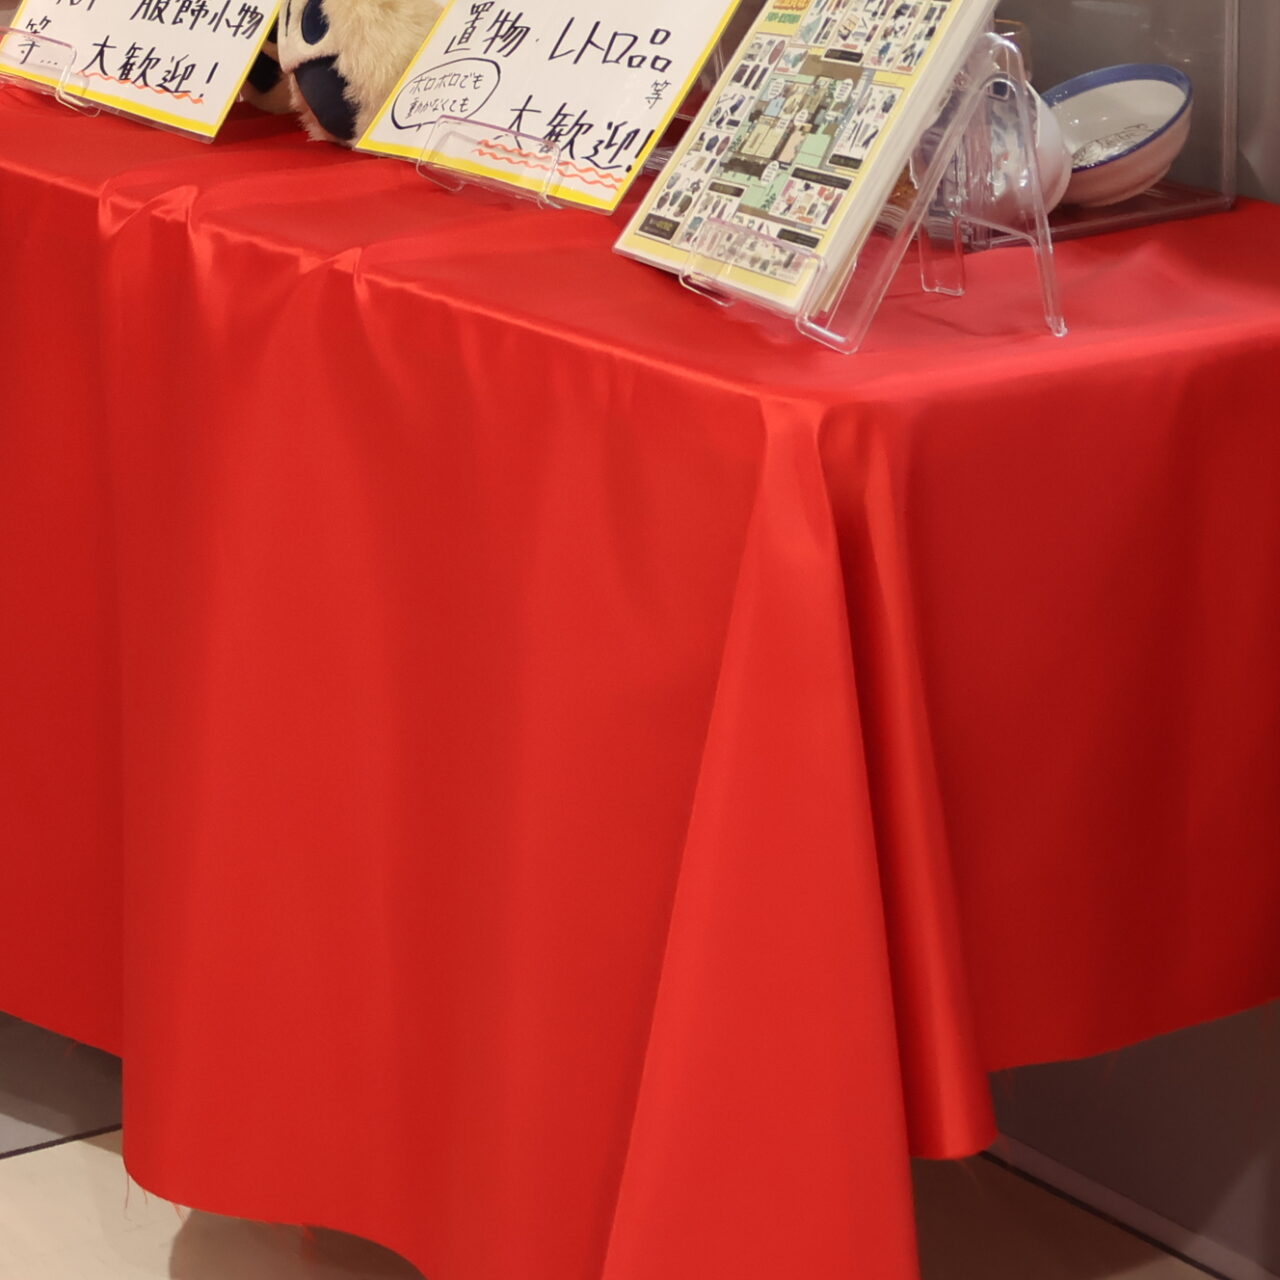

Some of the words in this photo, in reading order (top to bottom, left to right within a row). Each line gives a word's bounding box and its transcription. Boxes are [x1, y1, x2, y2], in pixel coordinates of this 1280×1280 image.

[82, 34, 220, 99] 大歓迎!
[492, 93, 657, 173] 大歓迎!
